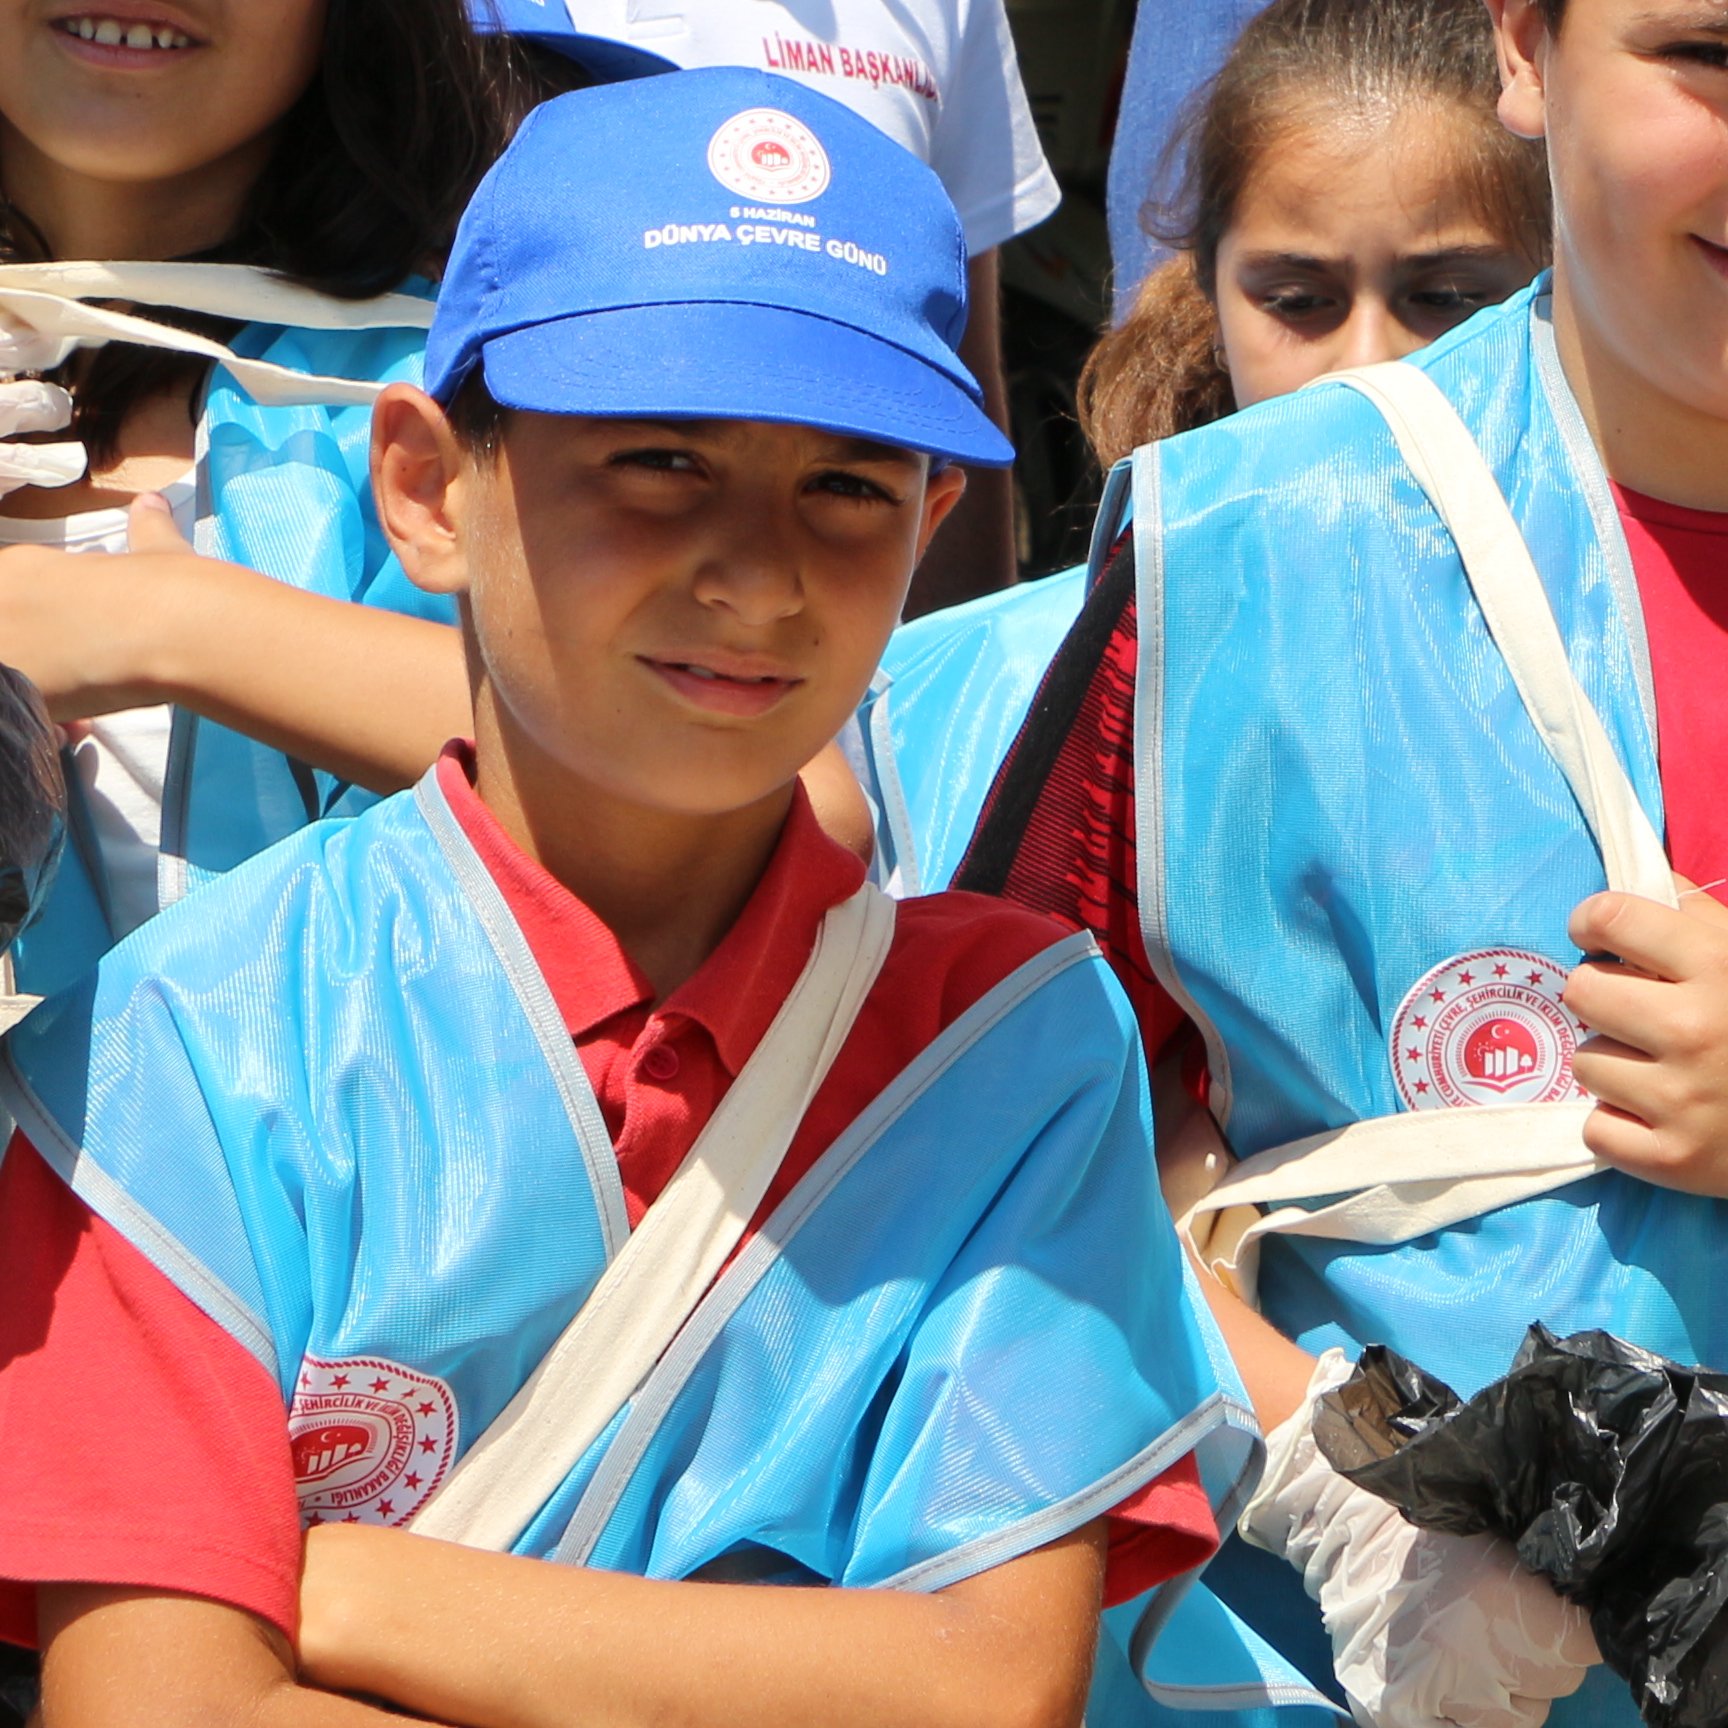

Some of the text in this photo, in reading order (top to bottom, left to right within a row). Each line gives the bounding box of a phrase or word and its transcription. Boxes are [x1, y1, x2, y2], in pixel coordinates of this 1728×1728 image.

[762, 30, 836, 76] LİMAN
[729, 205, 817, 228] 5 HAZİRAN
[643, 223, 888, 277] DÜNYA ÇEVRE GÜNÜ
[1438, 1002, 1468, 1033] ÇEVRE,
[1465, 984, 1524, 1011] ŞEHİRCİLİK
[1525, 992, 1539, 1007] VE
[1537, 998, 1564, 1028] İKLİM
[299, 1394, 365, 1415] ŞEHİRCİLİK
[365, 1400, 380, 1411] VE
[330, 1469, 391, 1506] BAKANLIĞI
